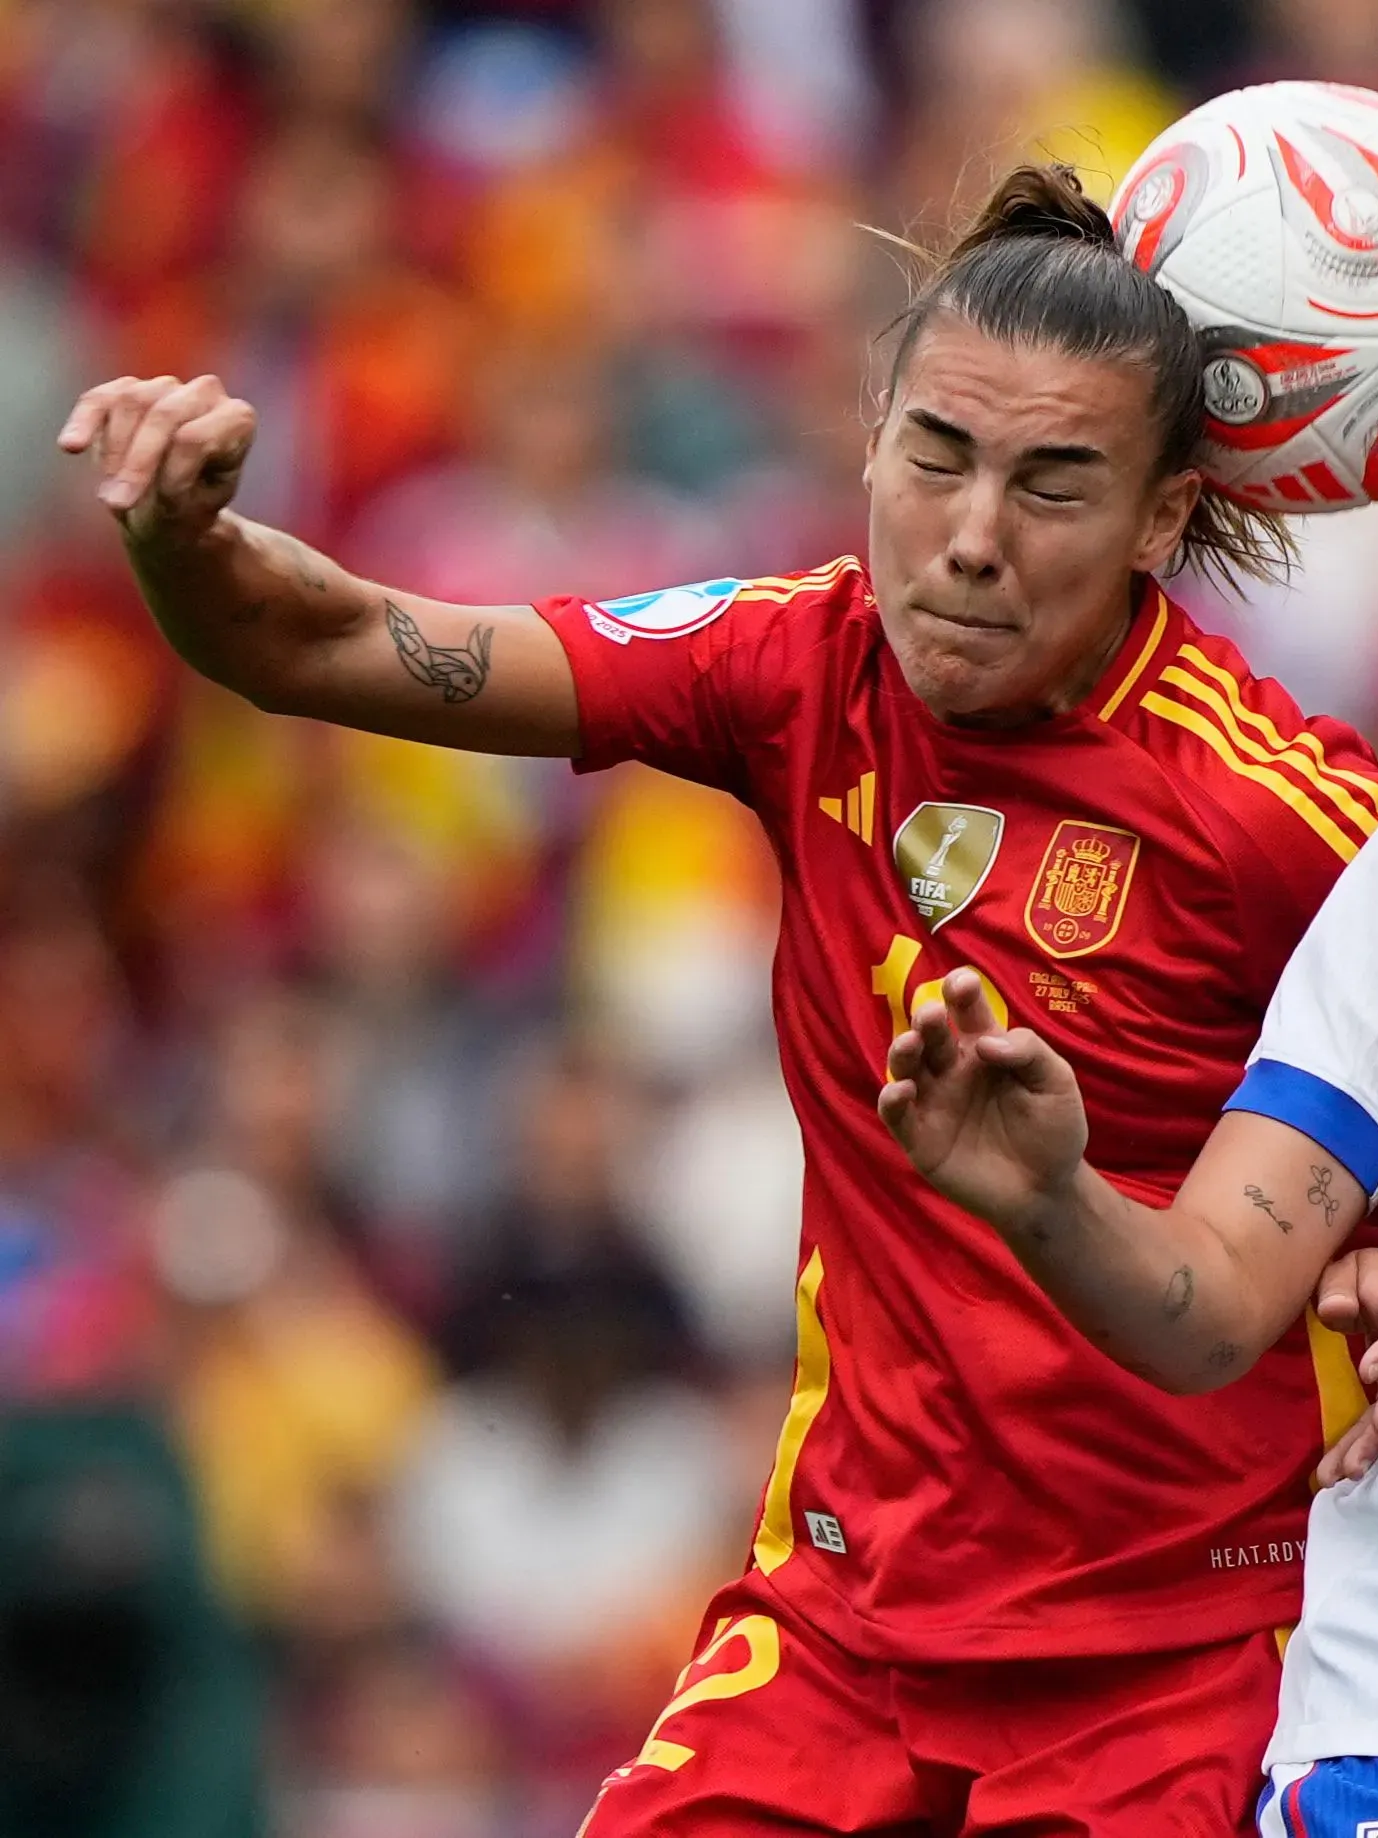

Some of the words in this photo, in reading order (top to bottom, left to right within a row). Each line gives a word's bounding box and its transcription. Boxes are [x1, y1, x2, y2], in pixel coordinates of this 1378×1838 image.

[595, 620, 627, 638] 2025
[911, 877, 946, 900] FIFA
[1035, 985, 1048, 997] 27
[1210, 1540, 1306, 1569] HEAT.RDY
